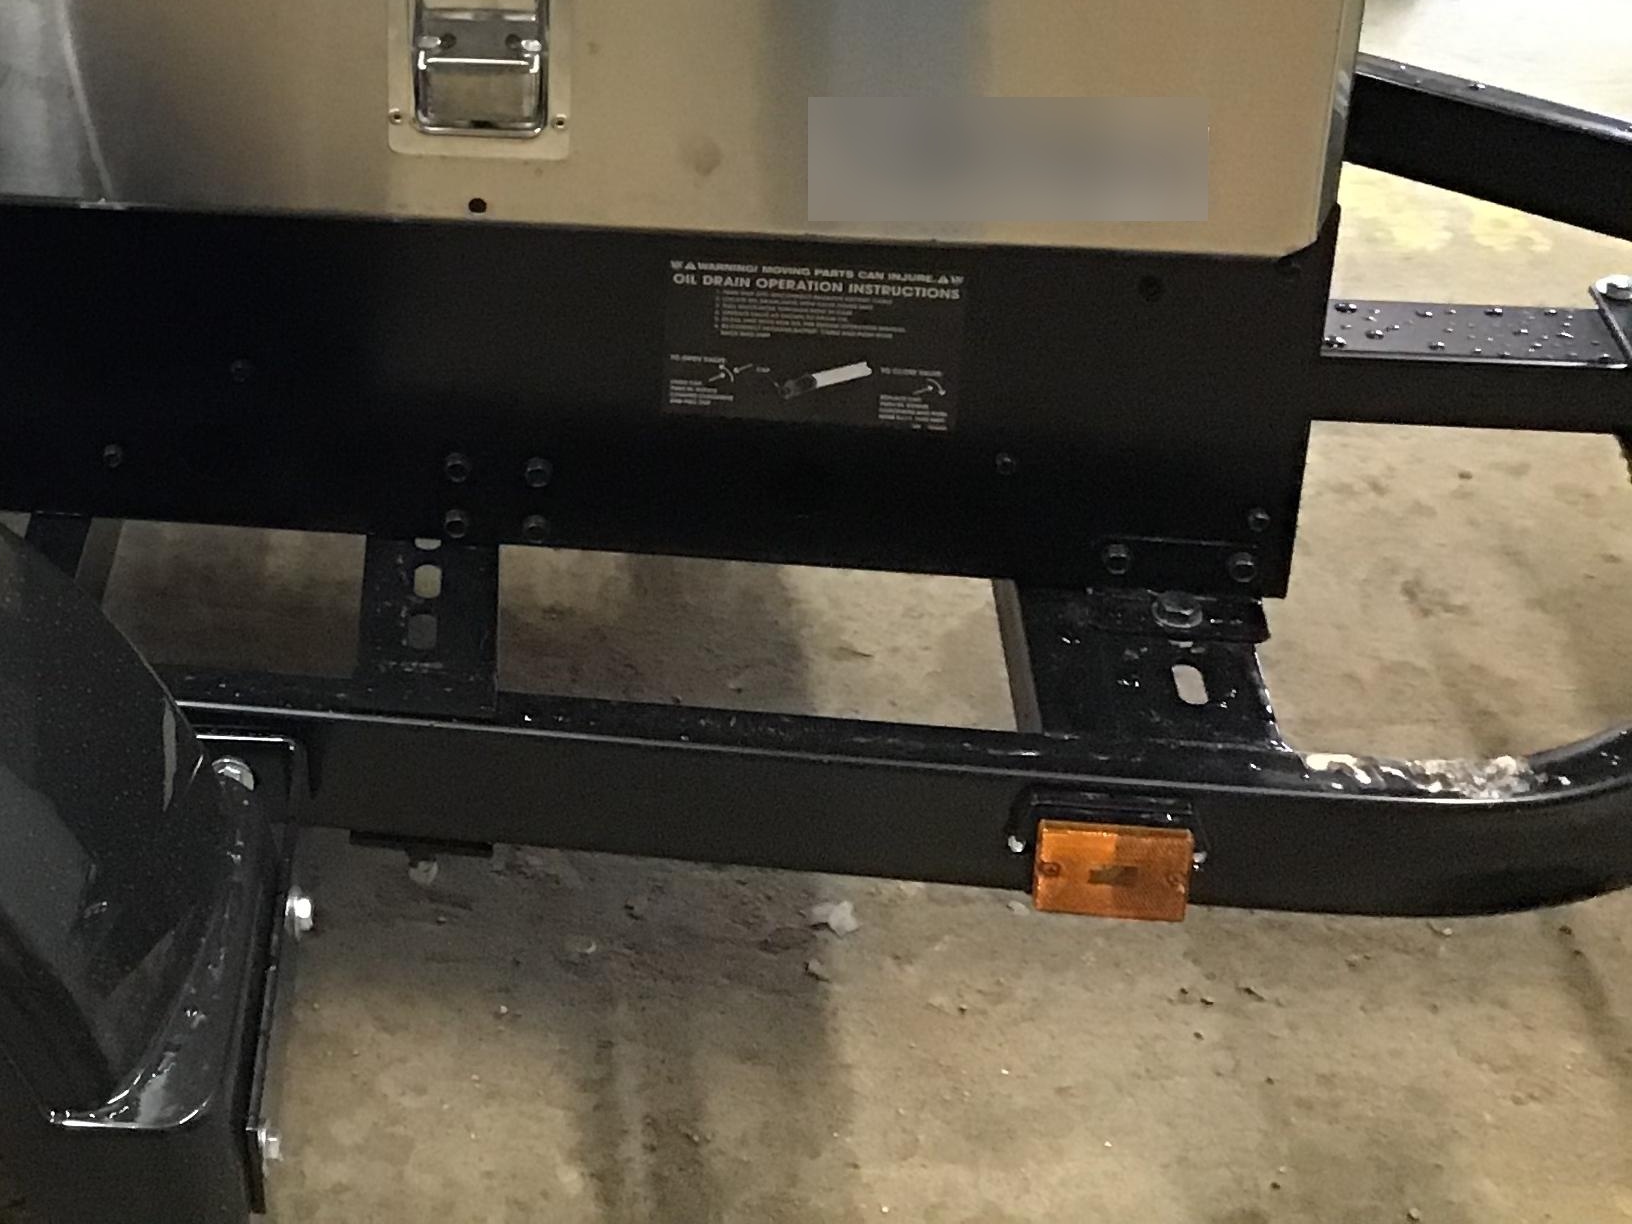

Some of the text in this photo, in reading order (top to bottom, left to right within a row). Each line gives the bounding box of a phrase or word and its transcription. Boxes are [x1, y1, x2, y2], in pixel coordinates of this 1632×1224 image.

[762, 265, 811, 276] MOVING
[814, 268, 855, 279] PARTS
[858, 271, 885, 281] CAN
[672, 273, 698, 286] OIL
[702, 274, 752, 288] DRAIN
[755, 277, 844, 293] OPERATION
[848, 282, 961, 300] INSTRUCTIONS
